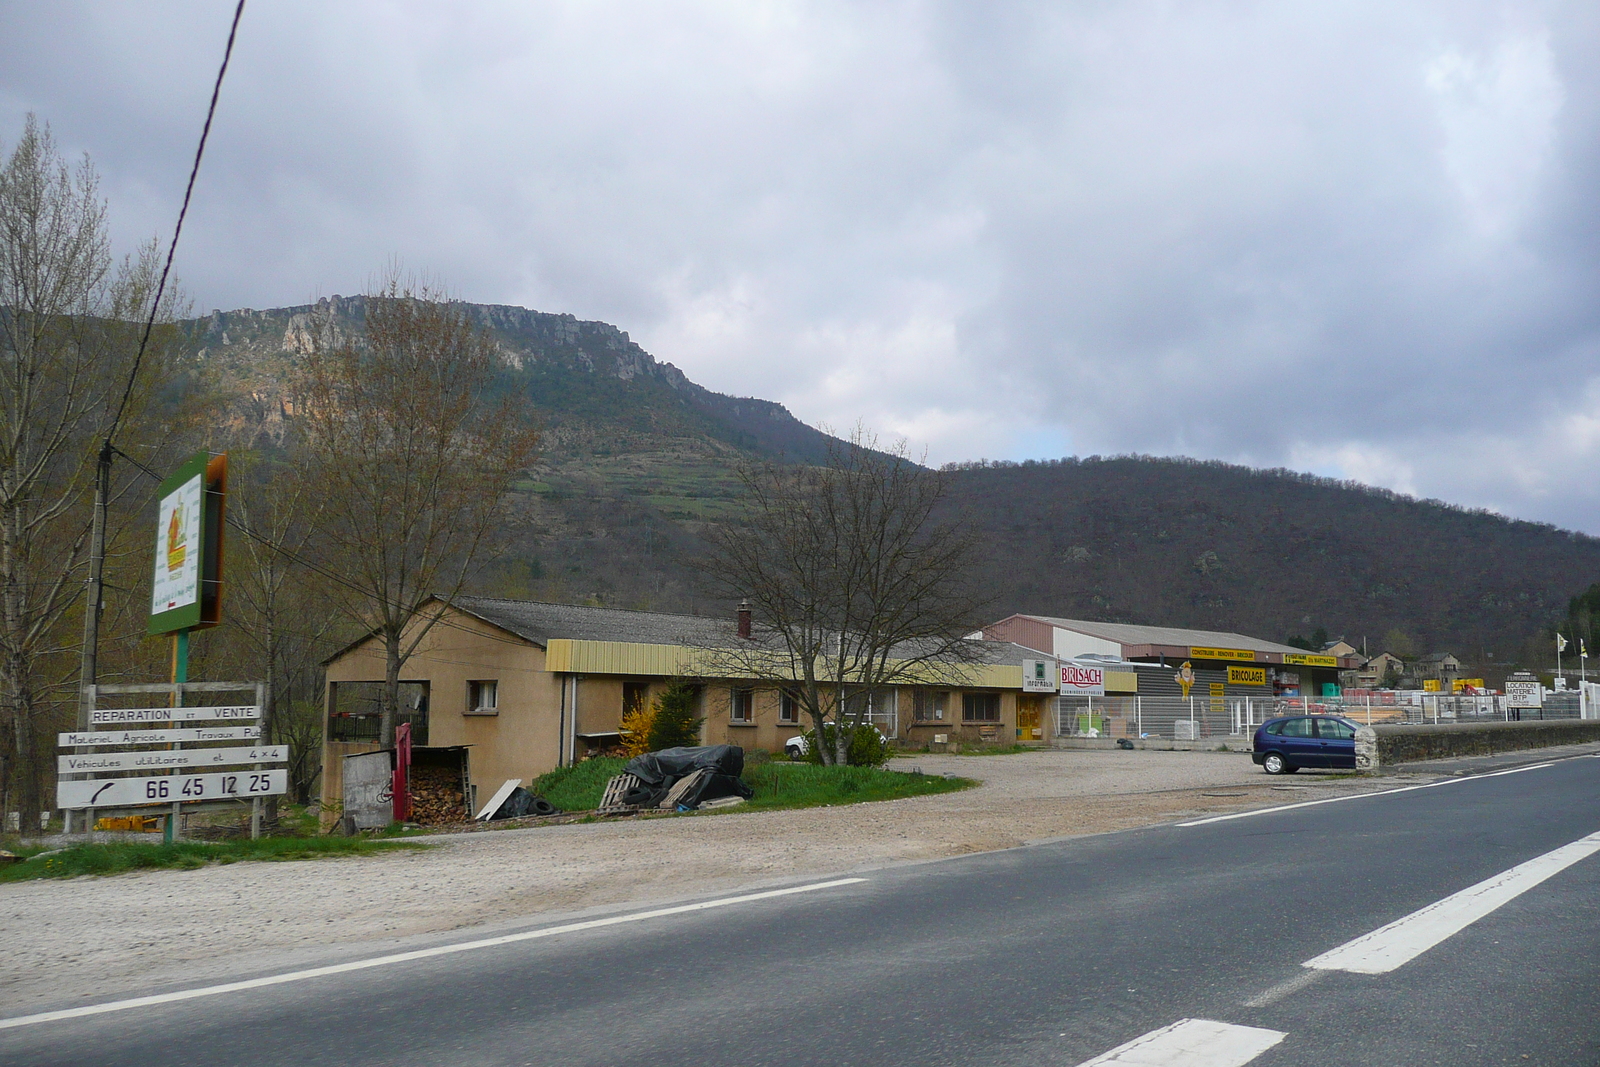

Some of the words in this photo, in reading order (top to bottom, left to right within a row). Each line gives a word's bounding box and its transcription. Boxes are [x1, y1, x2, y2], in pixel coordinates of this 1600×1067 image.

[1061, 667, 1102, 683] BRISACH
[1231, 670, 1263, 682] BRICOLAGE
[93, 710, 171, 722] REPARATION
[214, 707, 254, 718] VENTE
[123, 732, 165, 743] Agricole
[196, 730, 234, 740] Travaux
[135, 756, 188, 766] utilitaires
[213, 752, 224, 762] et
[146, 780, 169, 799] 66
[182, 778, 203, 796] 45
[221, 776, 237, 794] 12
[249, 774, 270, 792] 25
